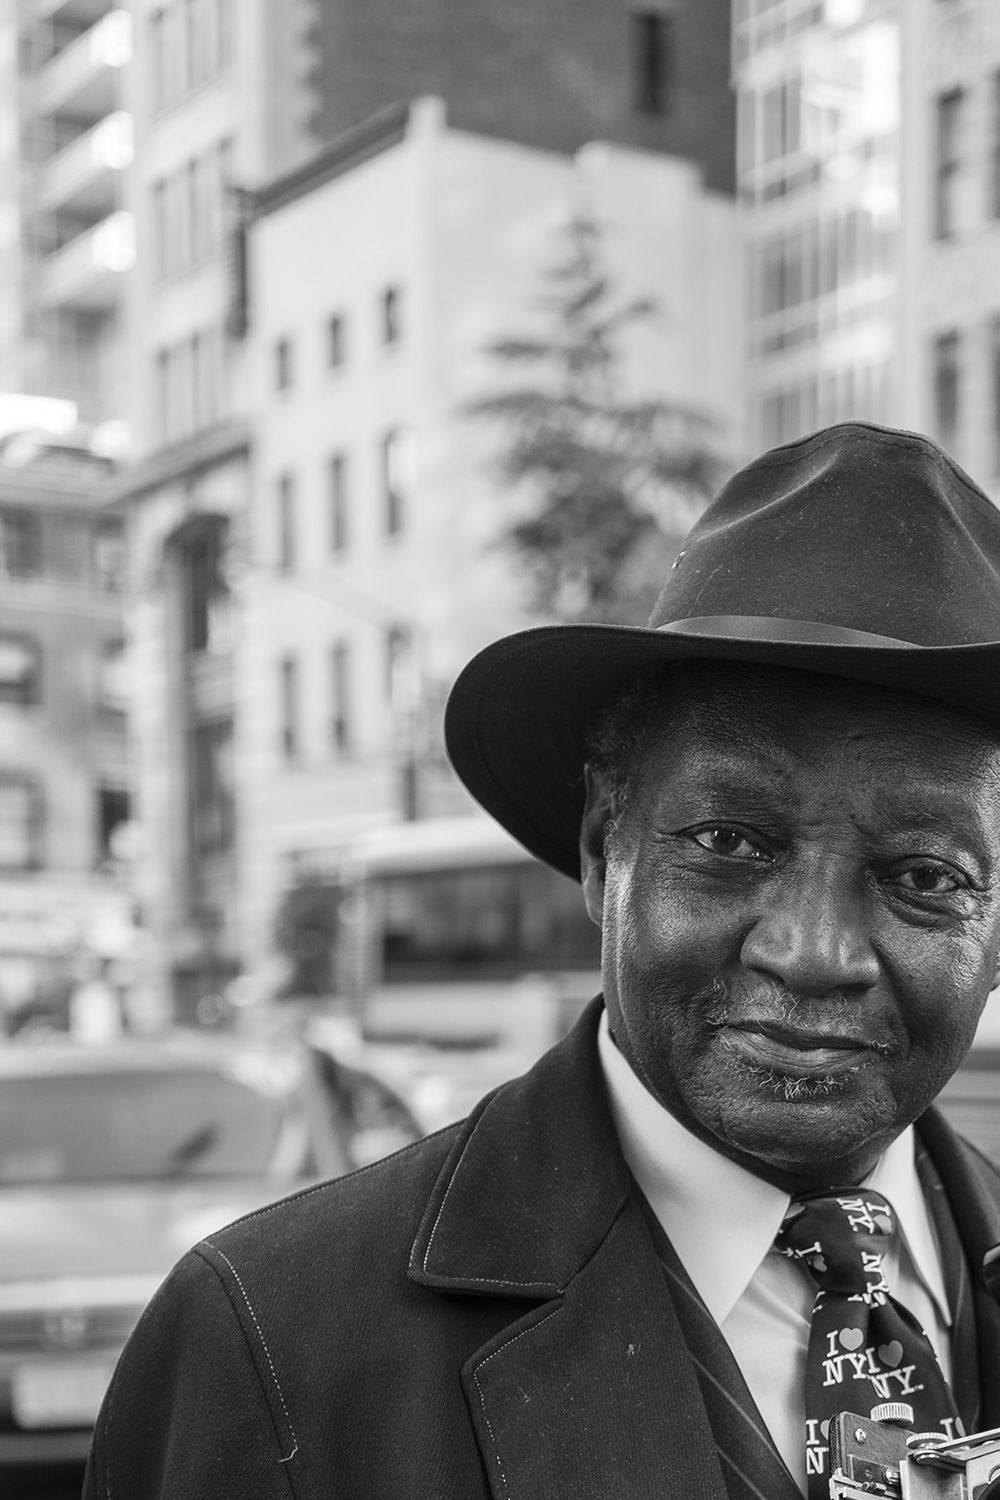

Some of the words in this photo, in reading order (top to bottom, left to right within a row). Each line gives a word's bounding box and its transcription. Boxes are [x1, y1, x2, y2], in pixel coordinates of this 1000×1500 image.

[826, 1330, 839, 1358] I
[821, 1352, 867, 1387] NY
[865, 1347, 881, 1374] I
[870, 1364, 916, 1399] NY
[805, 1419, 820, 1445] I
[806, 1447, 829, 1475] N
